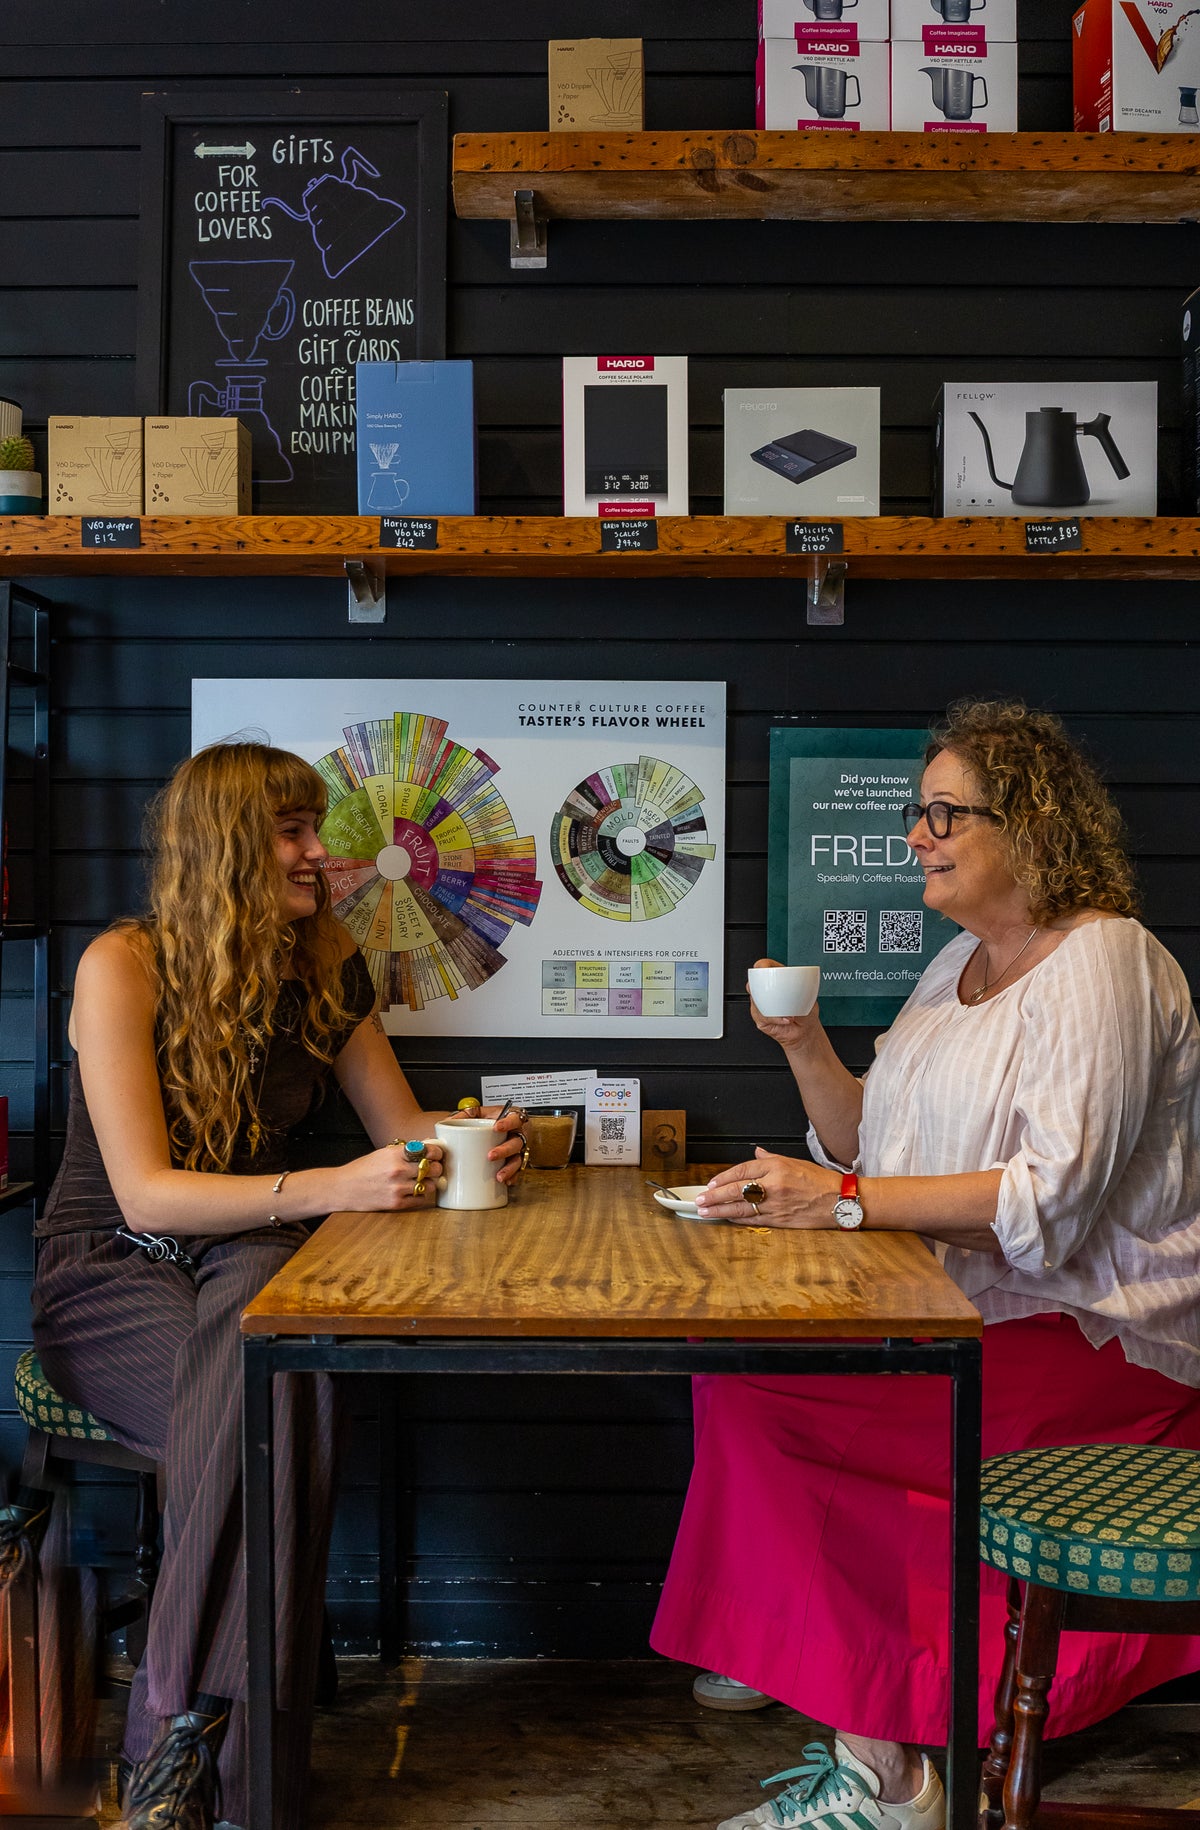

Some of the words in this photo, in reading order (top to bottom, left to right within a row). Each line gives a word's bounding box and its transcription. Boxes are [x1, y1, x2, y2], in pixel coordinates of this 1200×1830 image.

[807, 43, 849, 52] HARIO
[934, 45, 977, 54] HARIO
[218, 165, 258, 187] FOR
[194, 190, 261, 213] COFFEE
[198, 216, 272, 242] LOVERS
[303, 299, 361, 326] COFFEE
[365, 299, 414, 326] BEANS
[347, 339, 400, 362] CARDS
[606, 360, 645, 368] HARIO
[300, 376, 357, 402] COFFE
[291, 430, 357, 454] EQUIPM
[70, 461, 91, 470] Dripper
[166, 461, 187, 470] Dripper
[87, 521, 104, 530] V60
[106, 521, 134, 531] dripper
[383, 519, 408, 528] Hario
[410, 521, 432, 530] Glass
[1059, 526, 1078, 540] £85
[94, 533, 117, 544] £12
[396, 539, 415, 548] £42
[801, 543, 826, 552] £100
[518, 704, 581, 712] COUNTER
[589, 704, 647, 712] CULTURE
[656, 704, 706, 713] COFFEE
[518, 716, 586, 726] TASTER'S
[592, 716, 650, 727] FLAVOR
[656, 717, 706, 727] WHEEL
[840, 774, 858, 784] Did
[860, 776, 879, 787] you
[880, 774, 909, 784] know
[400, 787, 411, 816] CITRUS
[834, 788, 864, 798] we've
[866, 788, 912, 798] launched
[375, 784, 389, 820] FLORAL
[855, 801, 886, 811] coffee
[350, 804, 375, 838] VEGETAL
[426, 809, 444, 827] GRAPE
[606, 811, 634, 831] MOLD
[642, 808, 660, 823] AGED
[334, 819, 366, 842] EARTHY
[435, 824, 463, 841] TROPICAL
[581, 825, 589, 851] ROTTEN
[649, 832, 671, 841] TAINTED
[327, 836, 352, 850] HERB
[438, 835, 456, 846] FRUIT
[402, 829, 430, 877] FRUIT
[602, 849, 618, 867] FRUIT
[329, 875, 357, 894] PICE
[441, 874, 467, 887] BERRY
[817, 873, 860, 883] Speciality
[862, 873, 892, 883] Coffee
[894, 873, 926, 883] Roaste
[335, 896, 357, 917] ROAST
[414, 887, 450, 929] CHOCOLATE
[356, 908, 374, 935] CEREAL
[395, 900, 408, 939] SUGARY
[404, 897, 420, 928] SWEET
[415, 931, 424, 939] &
[375, 919, 387, 939] NUT
[822, 970, 922, 981] www.freda.coffee
[594, 1087, 631, 1100] Google
[652, 1123, 678, 1158] 3
